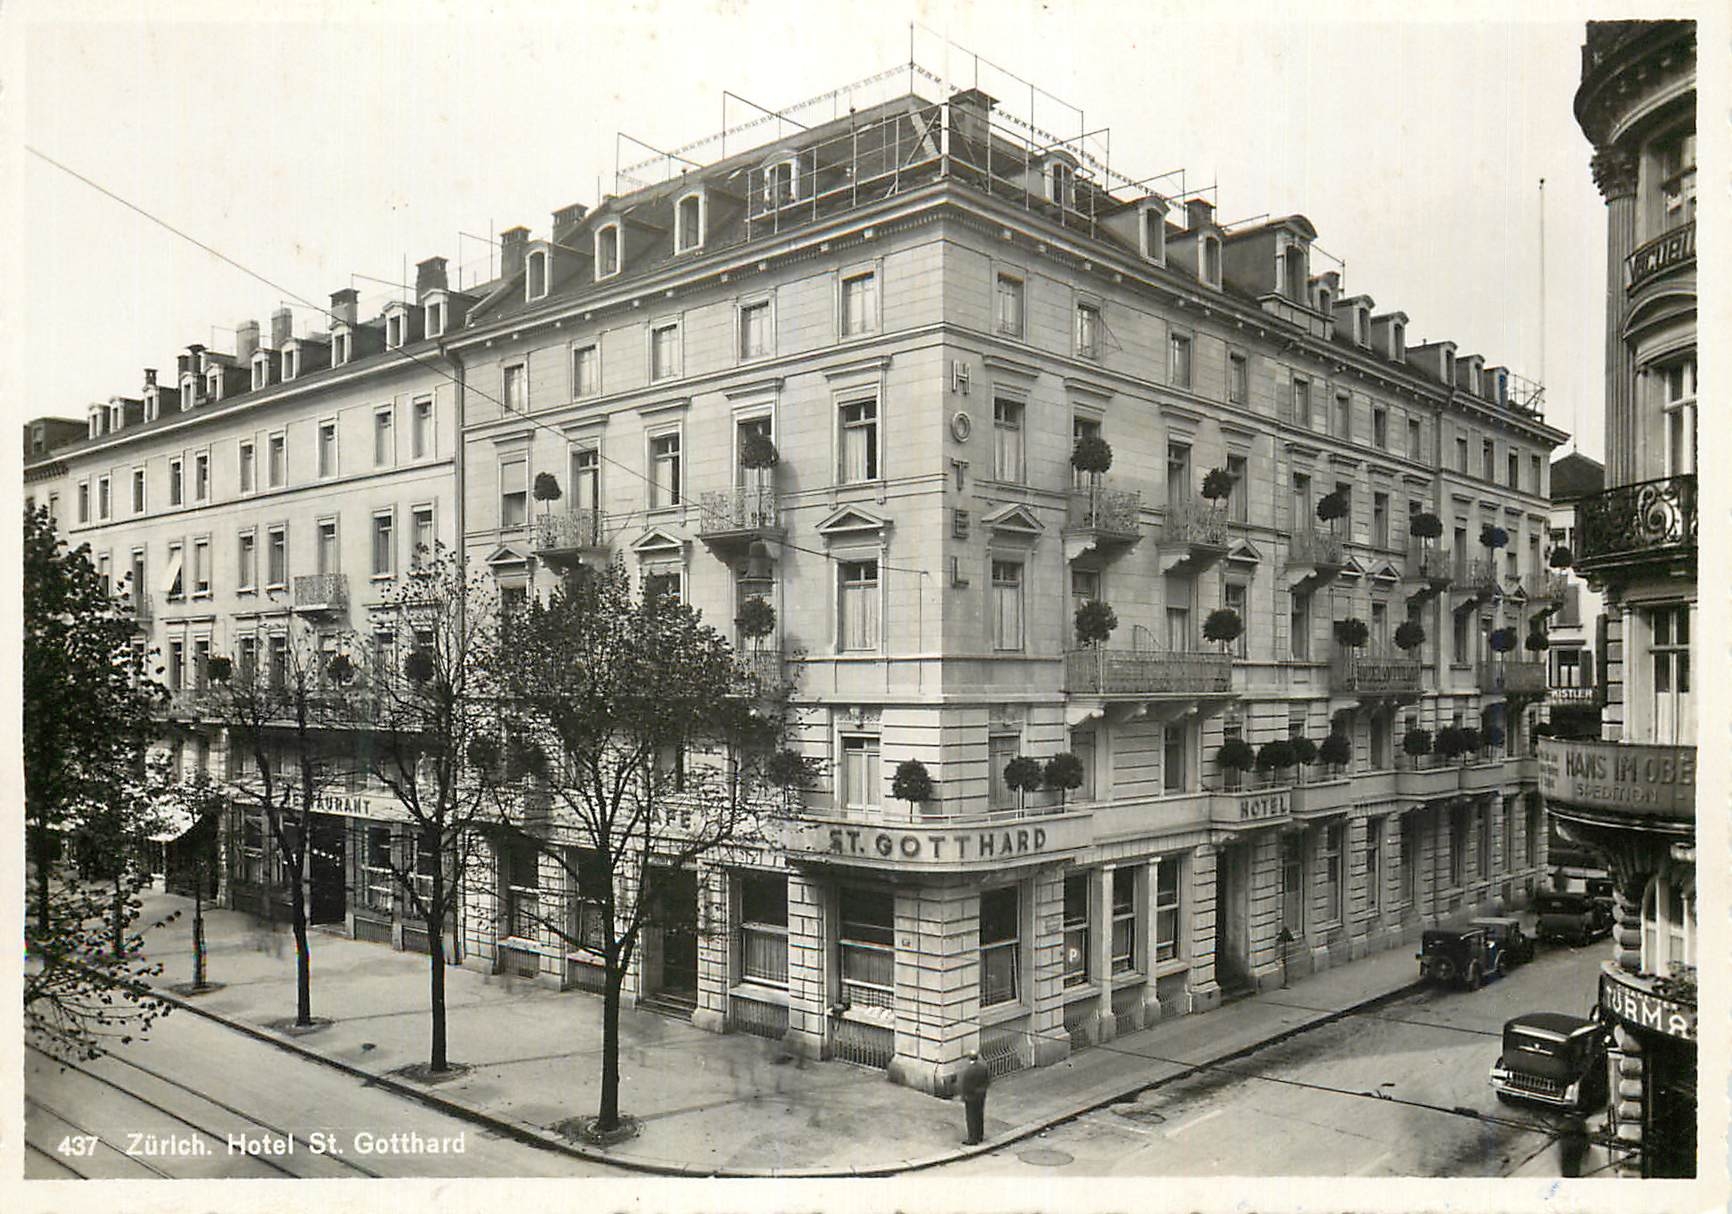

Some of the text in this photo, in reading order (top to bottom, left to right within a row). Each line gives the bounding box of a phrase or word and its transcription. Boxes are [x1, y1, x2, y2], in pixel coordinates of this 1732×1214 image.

[950, 358, 972, 590] HOTEL
[1565, 750, 1607, 780] HANS
[1614, 754, 1638, 783] IM
[1240, 796, 1288, 819] HOTEL
[829, 827, 1047, 859] ST. GOTTHARD
